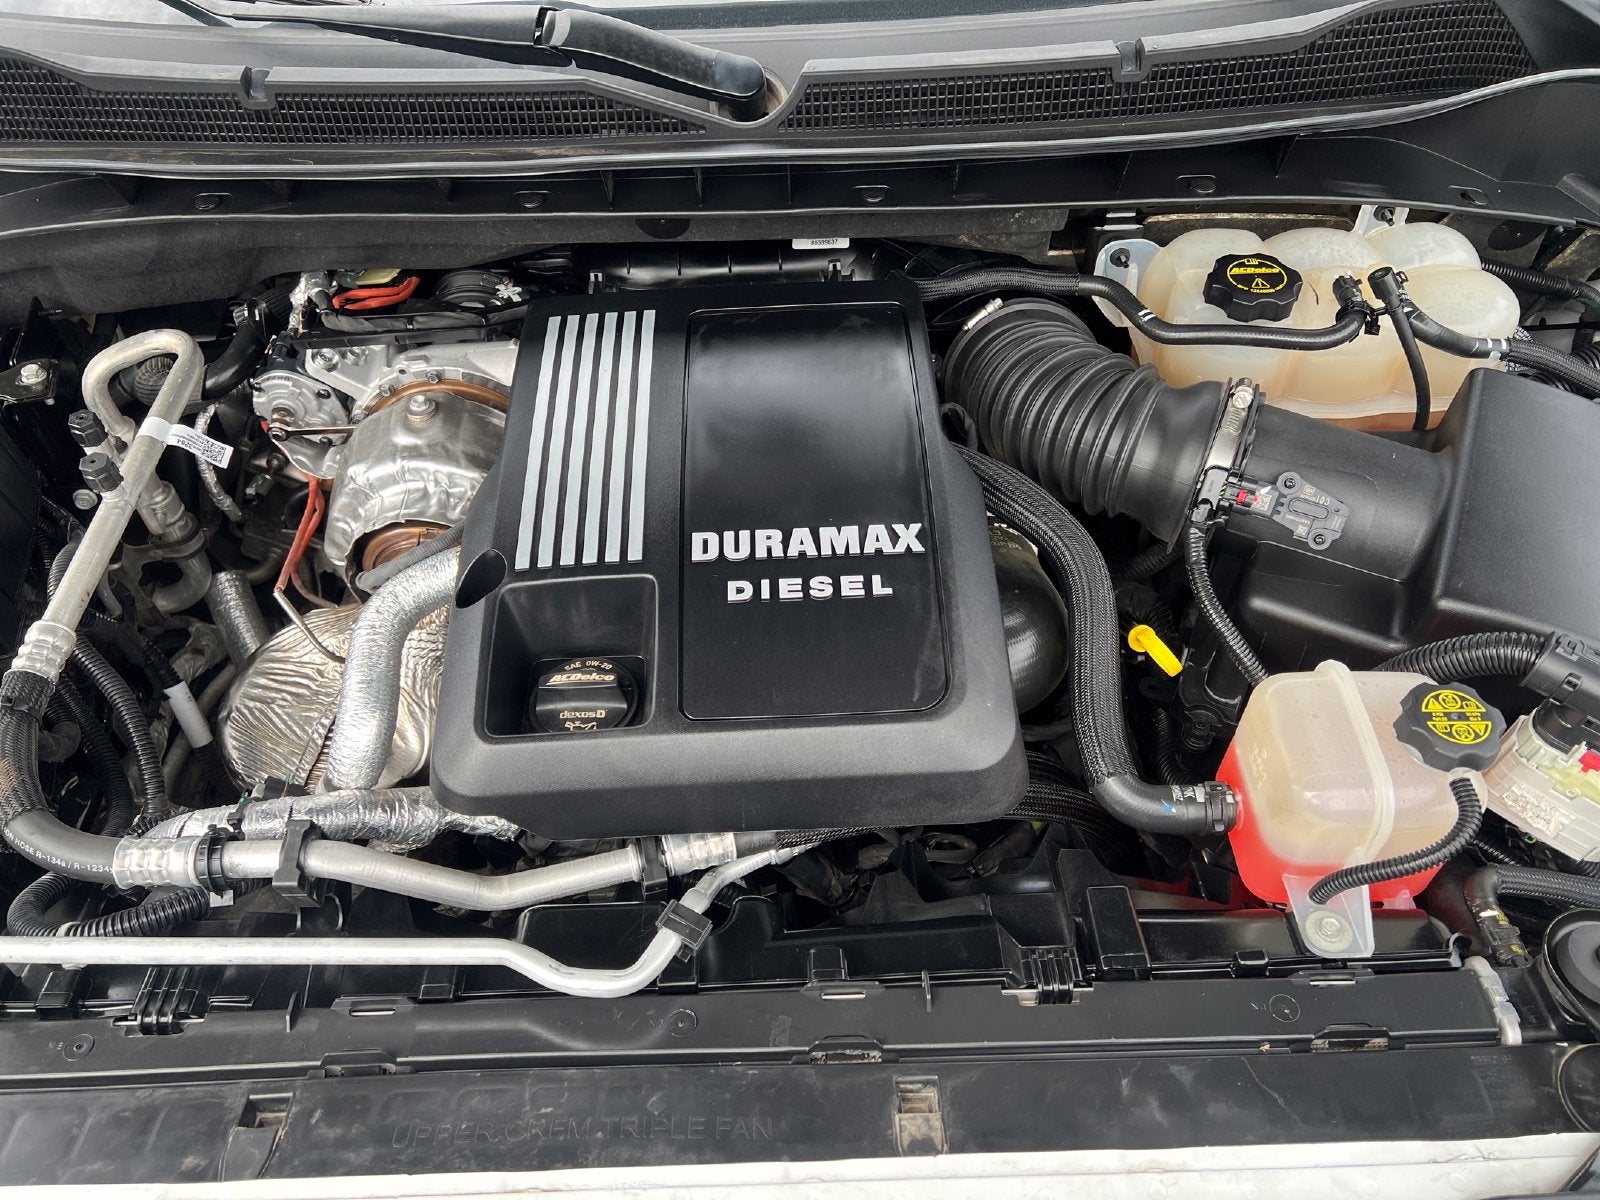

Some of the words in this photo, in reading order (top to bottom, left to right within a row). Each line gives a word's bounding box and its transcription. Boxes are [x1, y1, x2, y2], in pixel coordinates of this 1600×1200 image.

[691, 523, 925, 563] DURAMAX
[727, 574, 893, 604] DIESEL
[548, 672, 616, 682] ACDelco
[564, 661, 582, 671] SAE
[14, 837, 35, 856] HOSE
[36, 850, 66, 867] R-134a
[602, 1115, 707, 1140] TRIPLE
[714, 1115, 773, 1141] FAN
